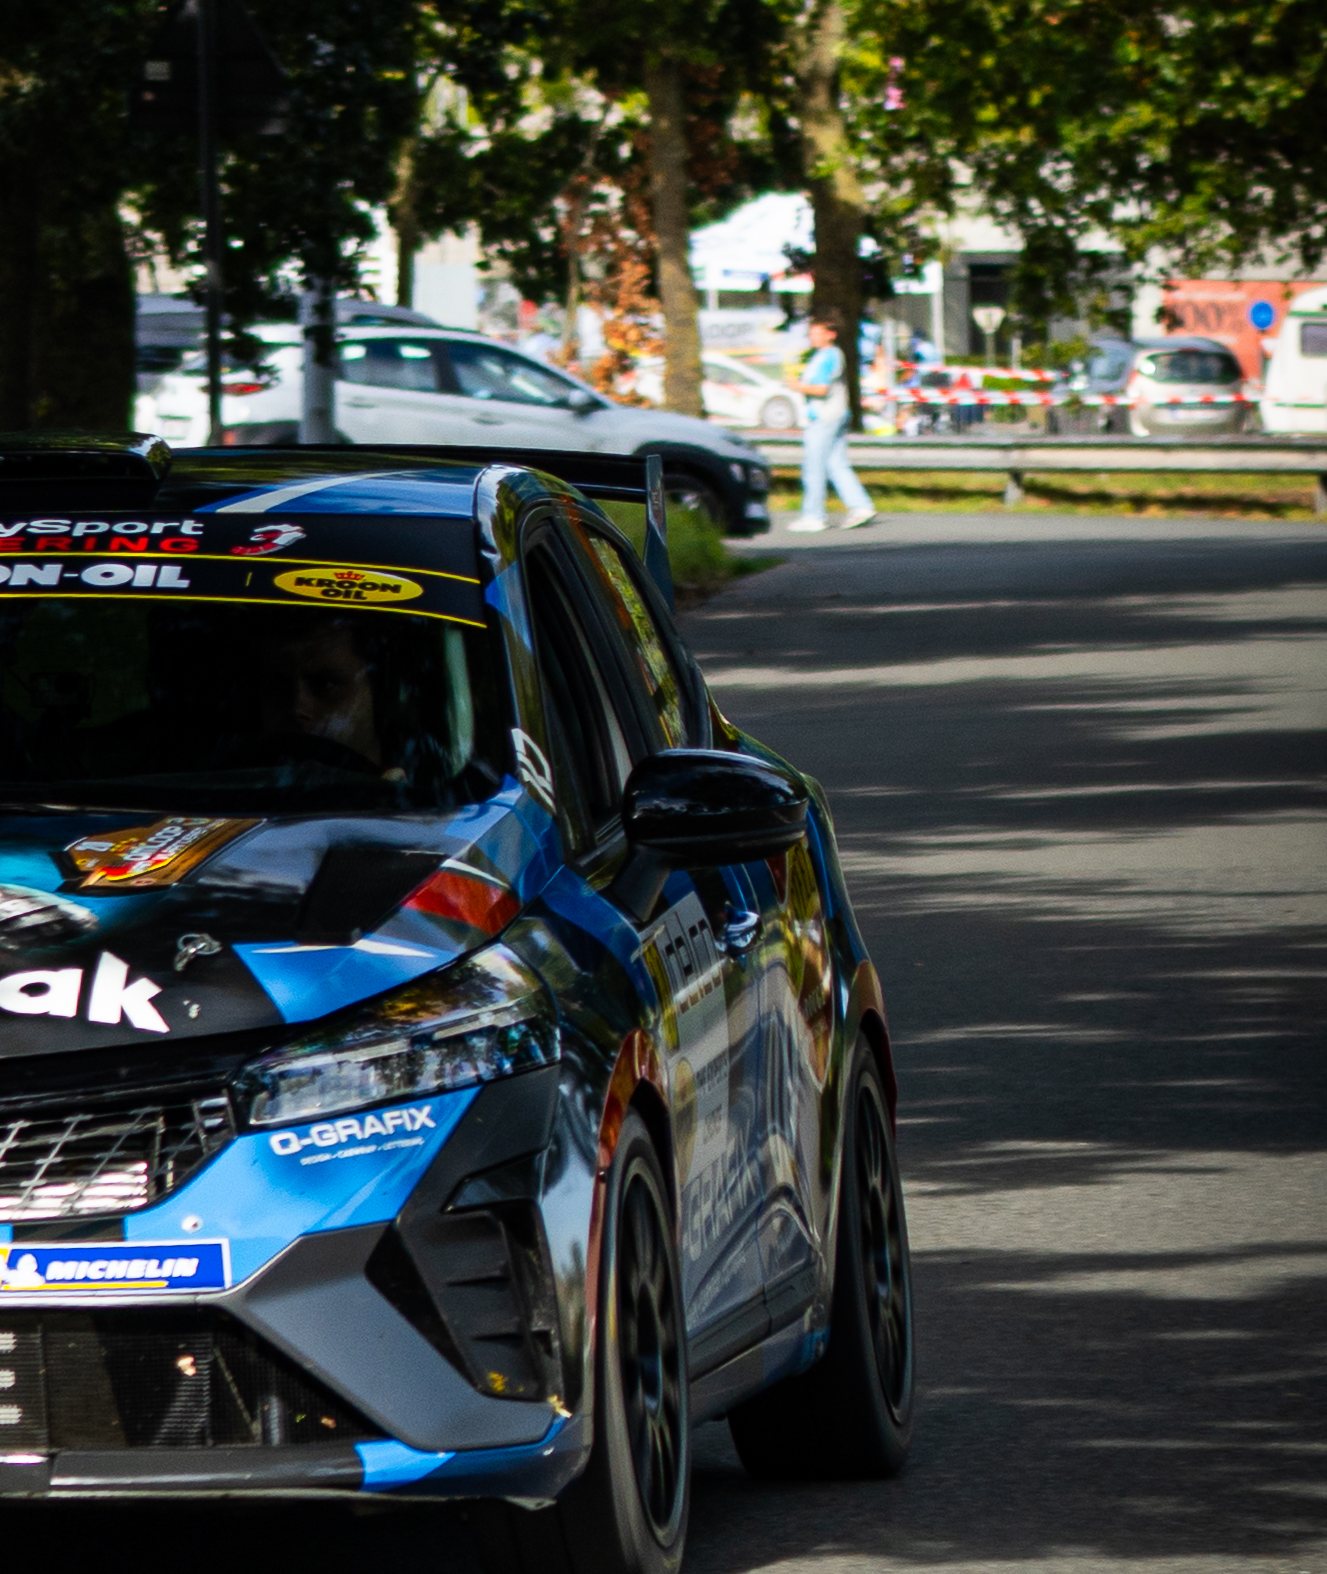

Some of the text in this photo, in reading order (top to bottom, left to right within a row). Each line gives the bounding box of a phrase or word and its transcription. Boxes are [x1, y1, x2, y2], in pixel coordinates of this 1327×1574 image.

[294, 577, 402, 594] KROON
[321, 588, 368, 600] OIL
[270, 1105, 436, 1156] Q-GRAFIX
[45, 1257, 199, 1281] MICHELIN
